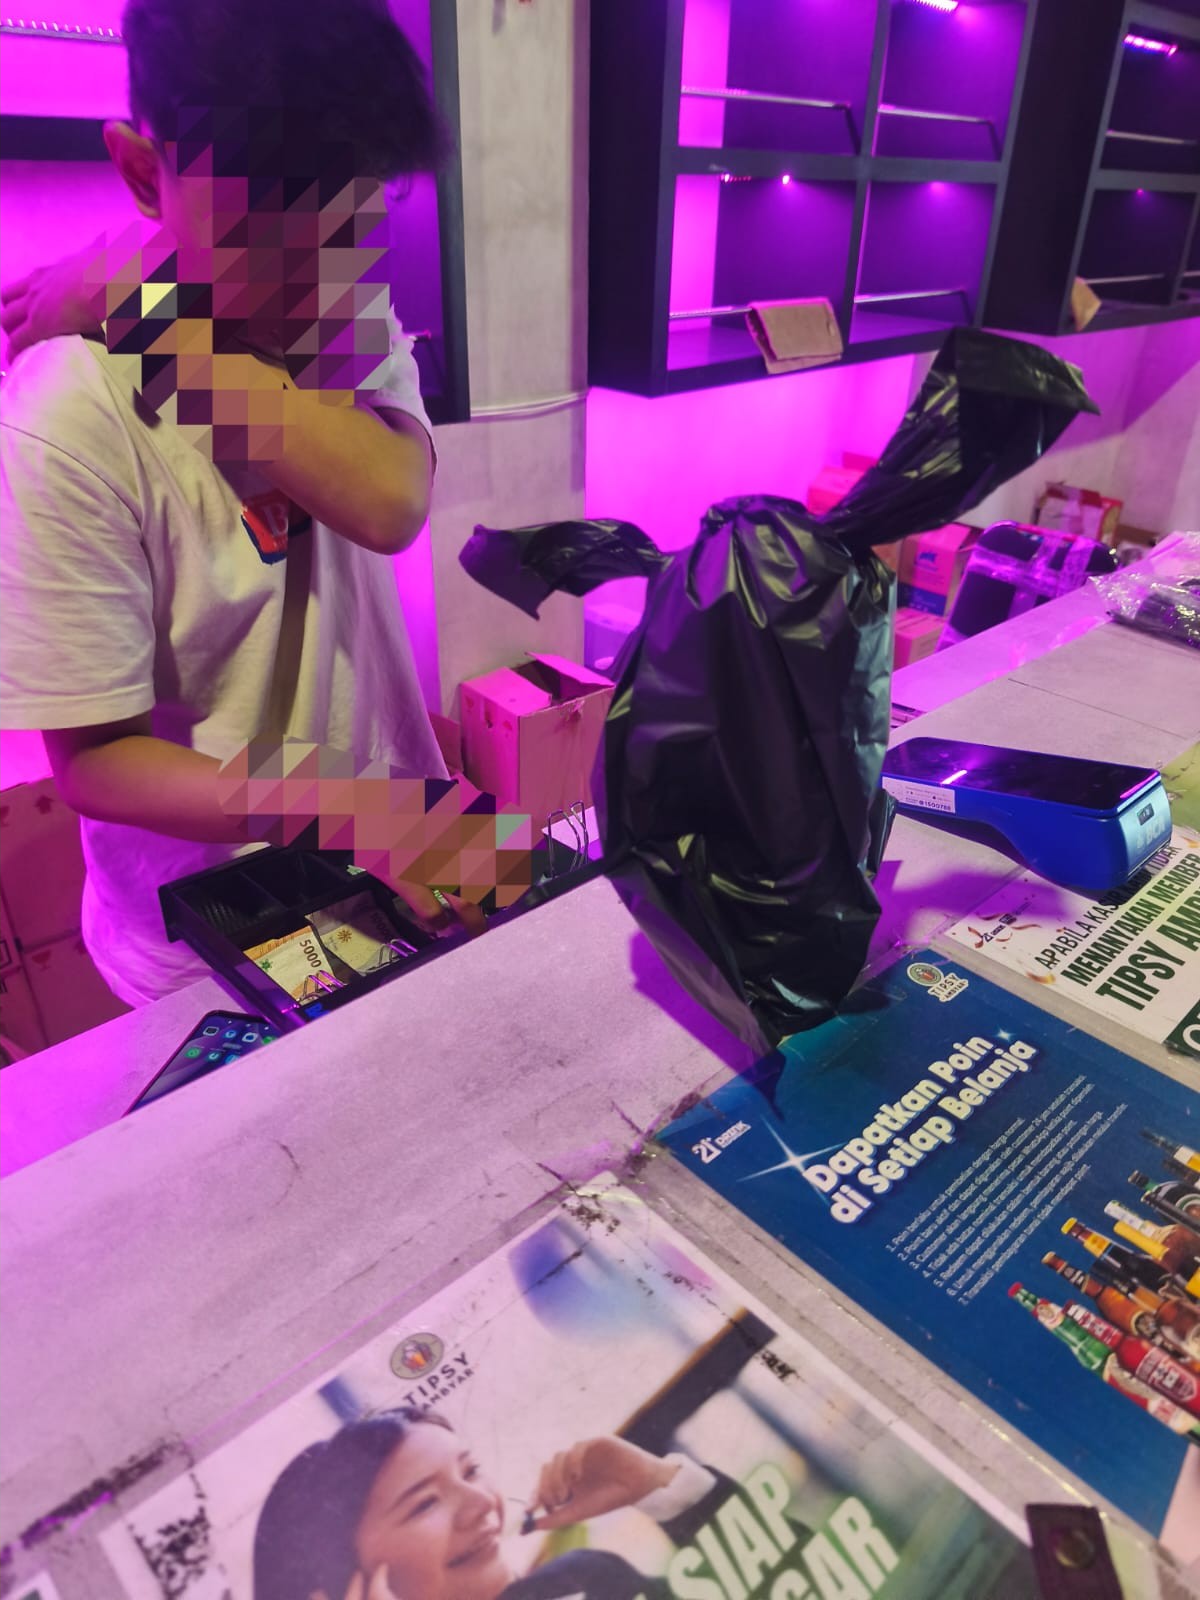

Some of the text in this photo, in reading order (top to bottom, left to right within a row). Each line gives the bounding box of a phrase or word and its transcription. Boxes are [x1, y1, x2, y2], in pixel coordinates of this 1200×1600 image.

[299, 939, 322, 968] 5000
[1034, 920, 1098, 970] APABILA
[1060, 898, 1165, 987] MENANYAKAN
[1095, 940, 1186, 1011] TIPSY
[931, 974, 959, 996] TIPSY
[802, 1036, 994, 1193] Dapatkan Poin
[830, 1040, 1037, 1223] di Setiap Belanja
[402, 1352, 468, 1406] TIPSY
[667, 1463, 797, 1600] SIAP
